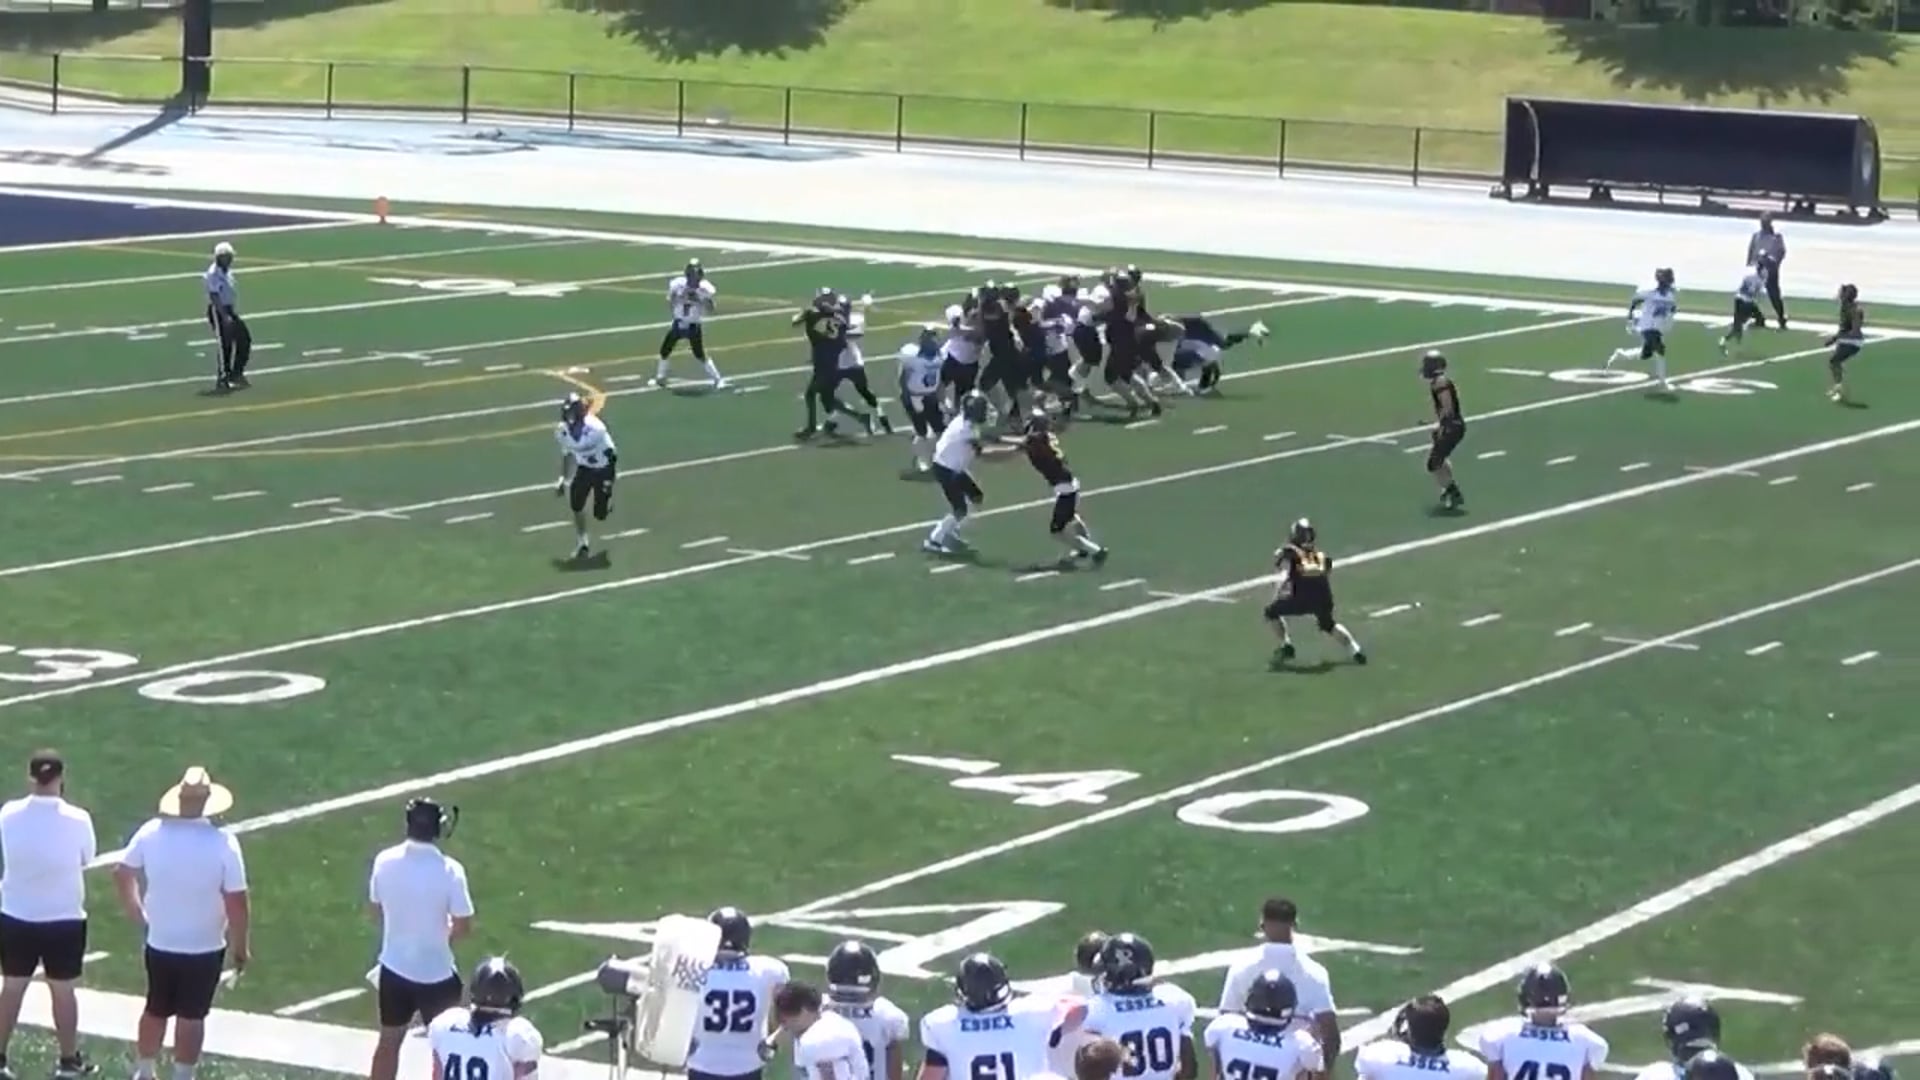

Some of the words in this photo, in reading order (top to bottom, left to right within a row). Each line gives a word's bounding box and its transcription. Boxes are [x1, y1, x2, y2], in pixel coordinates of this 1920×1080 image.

[949, 769, 1370, 833] 40
[704, 989, 756, 1032] 32
[961, 1015, 1015, 1031] ESSEX
[971, 1052, 1016, 1080] 61
